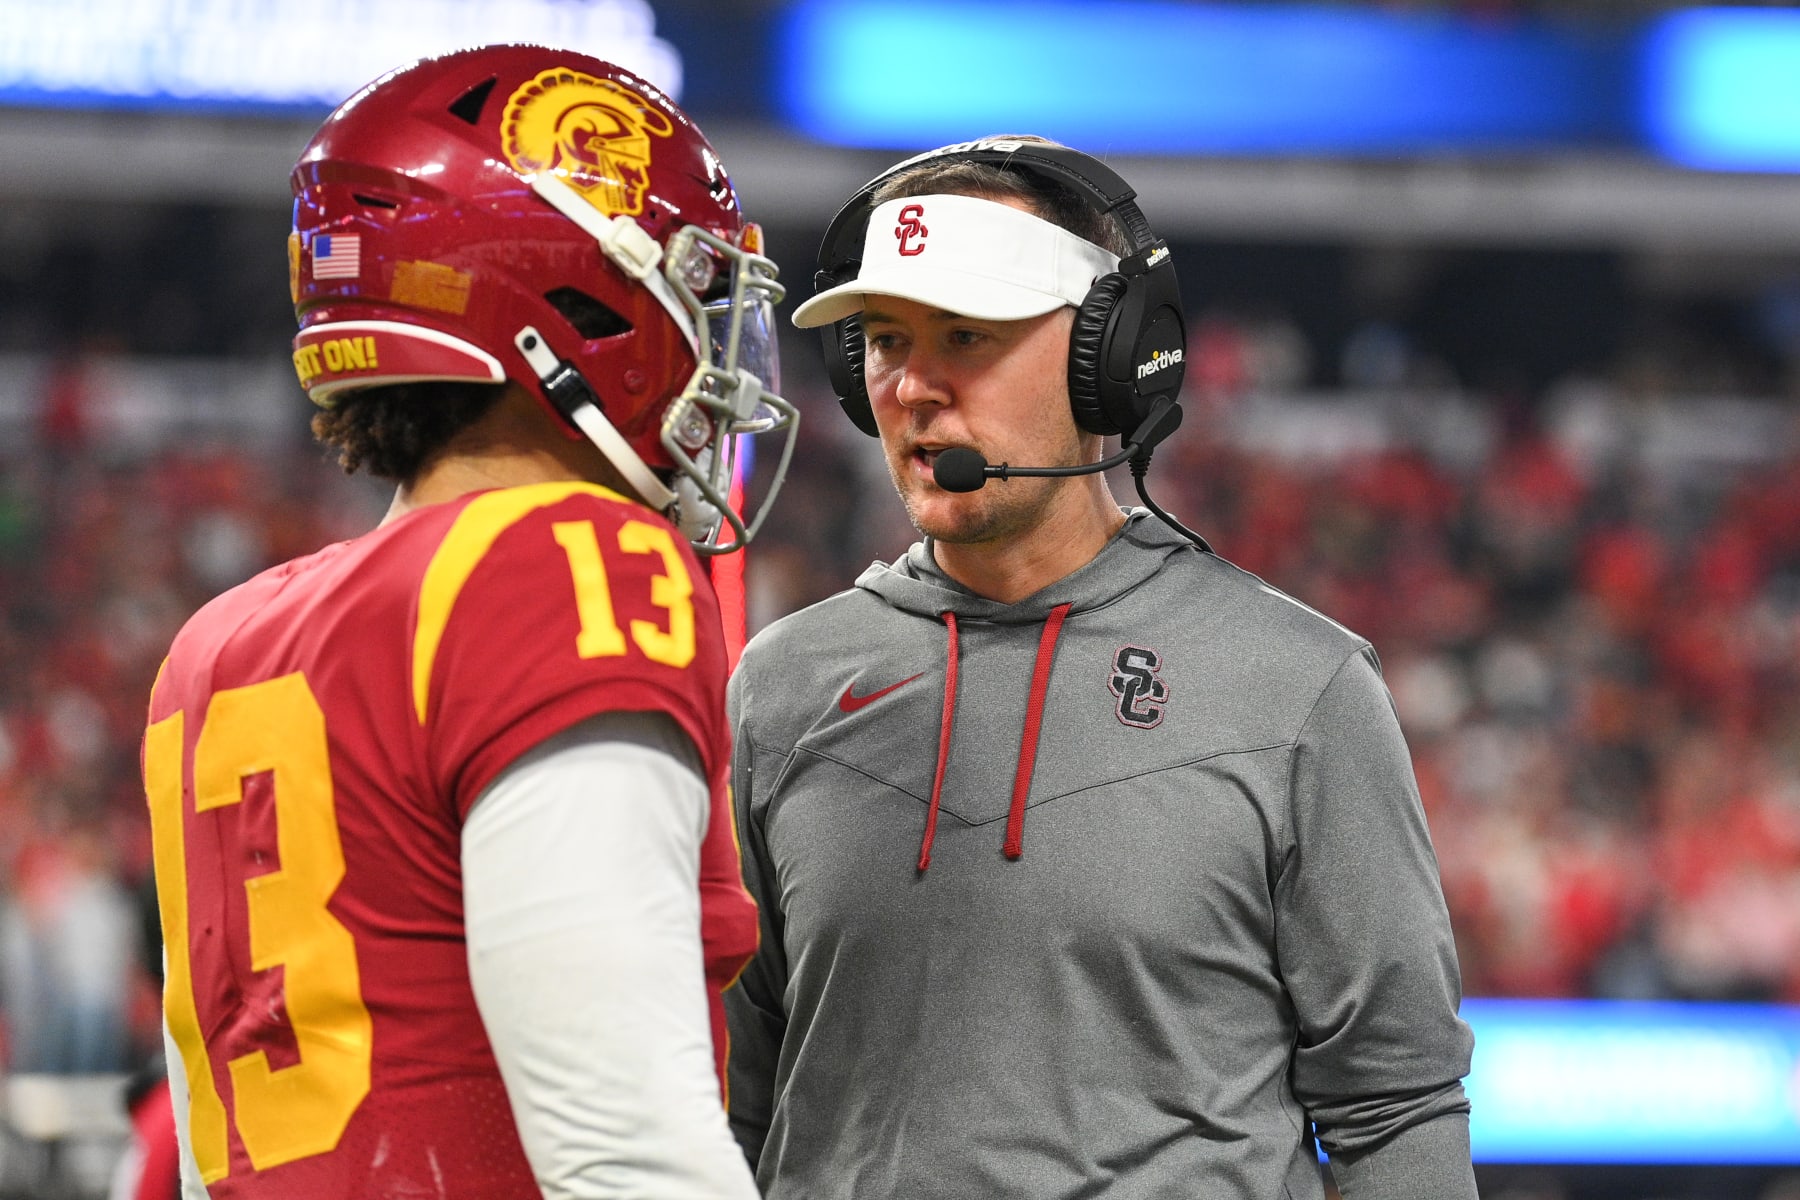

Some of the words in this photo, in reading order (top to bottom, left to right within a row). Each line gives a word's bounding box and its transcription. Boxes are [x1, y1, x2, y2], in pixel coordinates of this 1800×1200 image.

[322, 336, 378, 372] ON!
[1137, 349, 1183, 379] nextiva
[552, 519, 696, 668] 13
[145, 670, 373, 1186] 13
